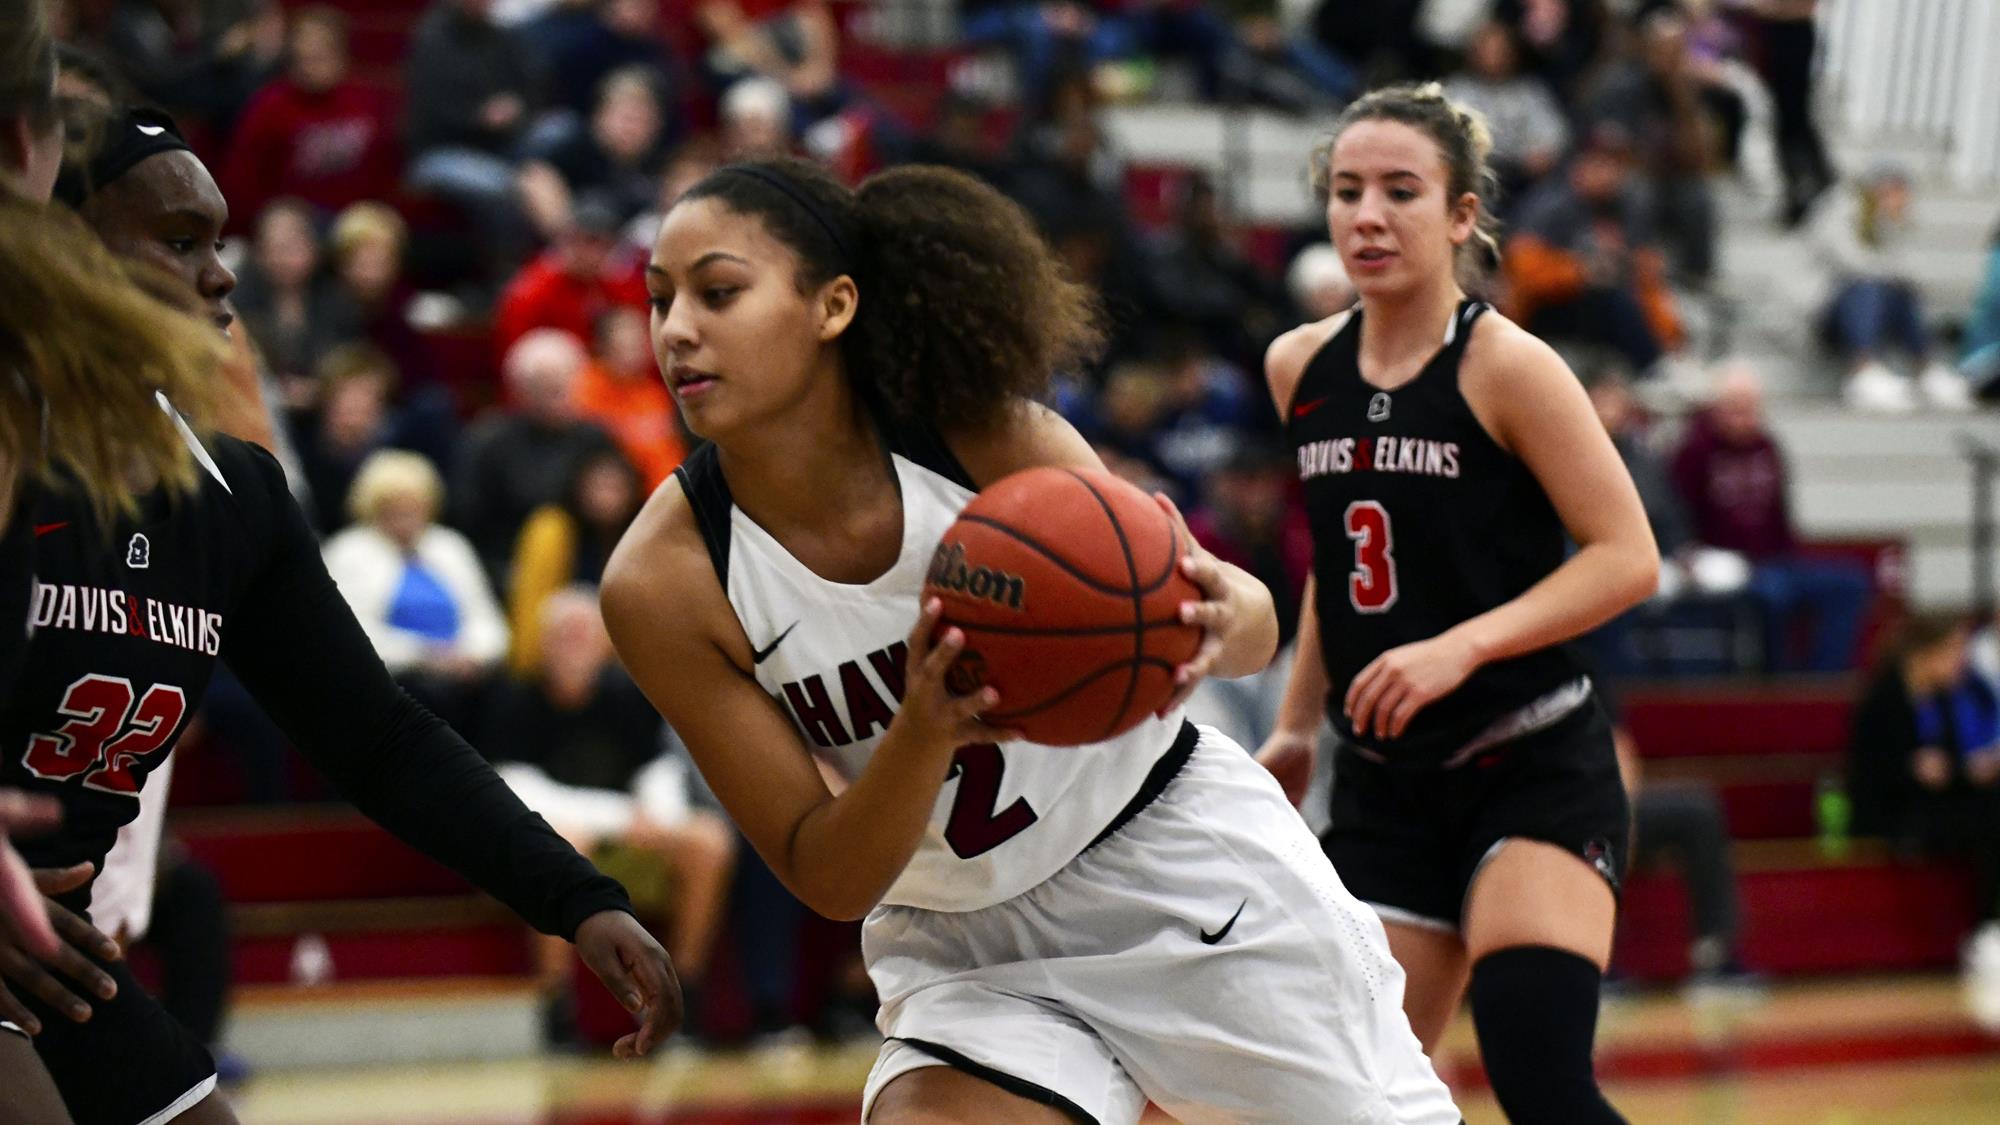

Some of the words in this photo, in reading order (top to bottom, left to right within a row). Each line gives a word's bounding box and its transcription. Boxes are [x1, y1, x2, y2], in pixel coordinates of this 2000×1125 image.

[1343, 499, 1399, 615] 3
[21, 672, 187, 797] 32
[944, 742, 1039, 860] 2
